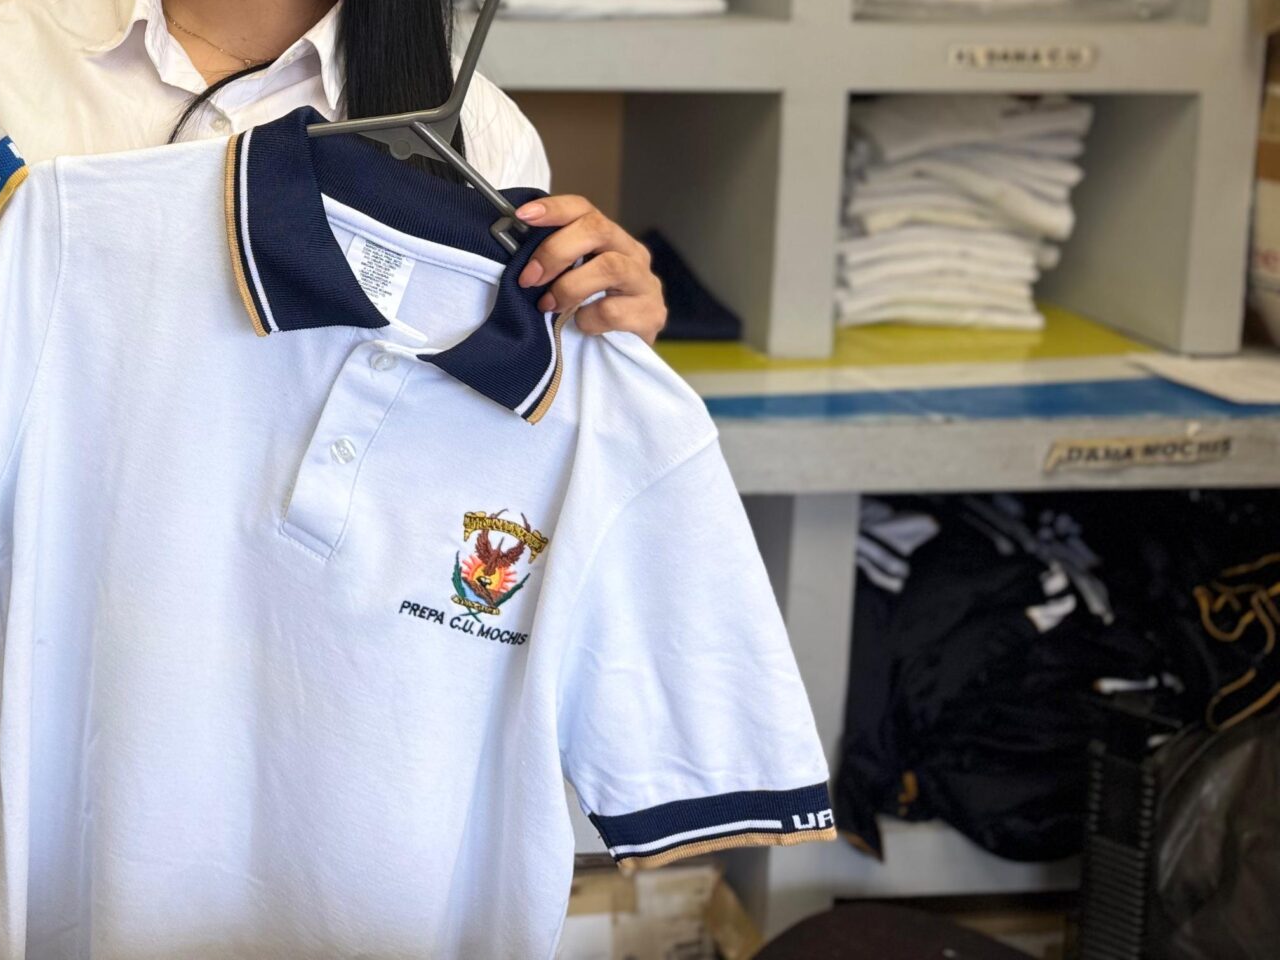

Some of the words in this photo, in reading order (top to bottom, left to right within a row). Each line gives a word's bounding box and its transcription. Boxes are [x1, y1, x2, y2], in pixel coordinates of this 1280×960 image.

[1066, 445, 1135, 462] DAMA
[1141, 438, 1233, 457] MOCHIS
[398, 599, 446, 626] PREPA
[449, 616, 474, 636] C.U.
[476, 623, 529, 646] MOCHIS
